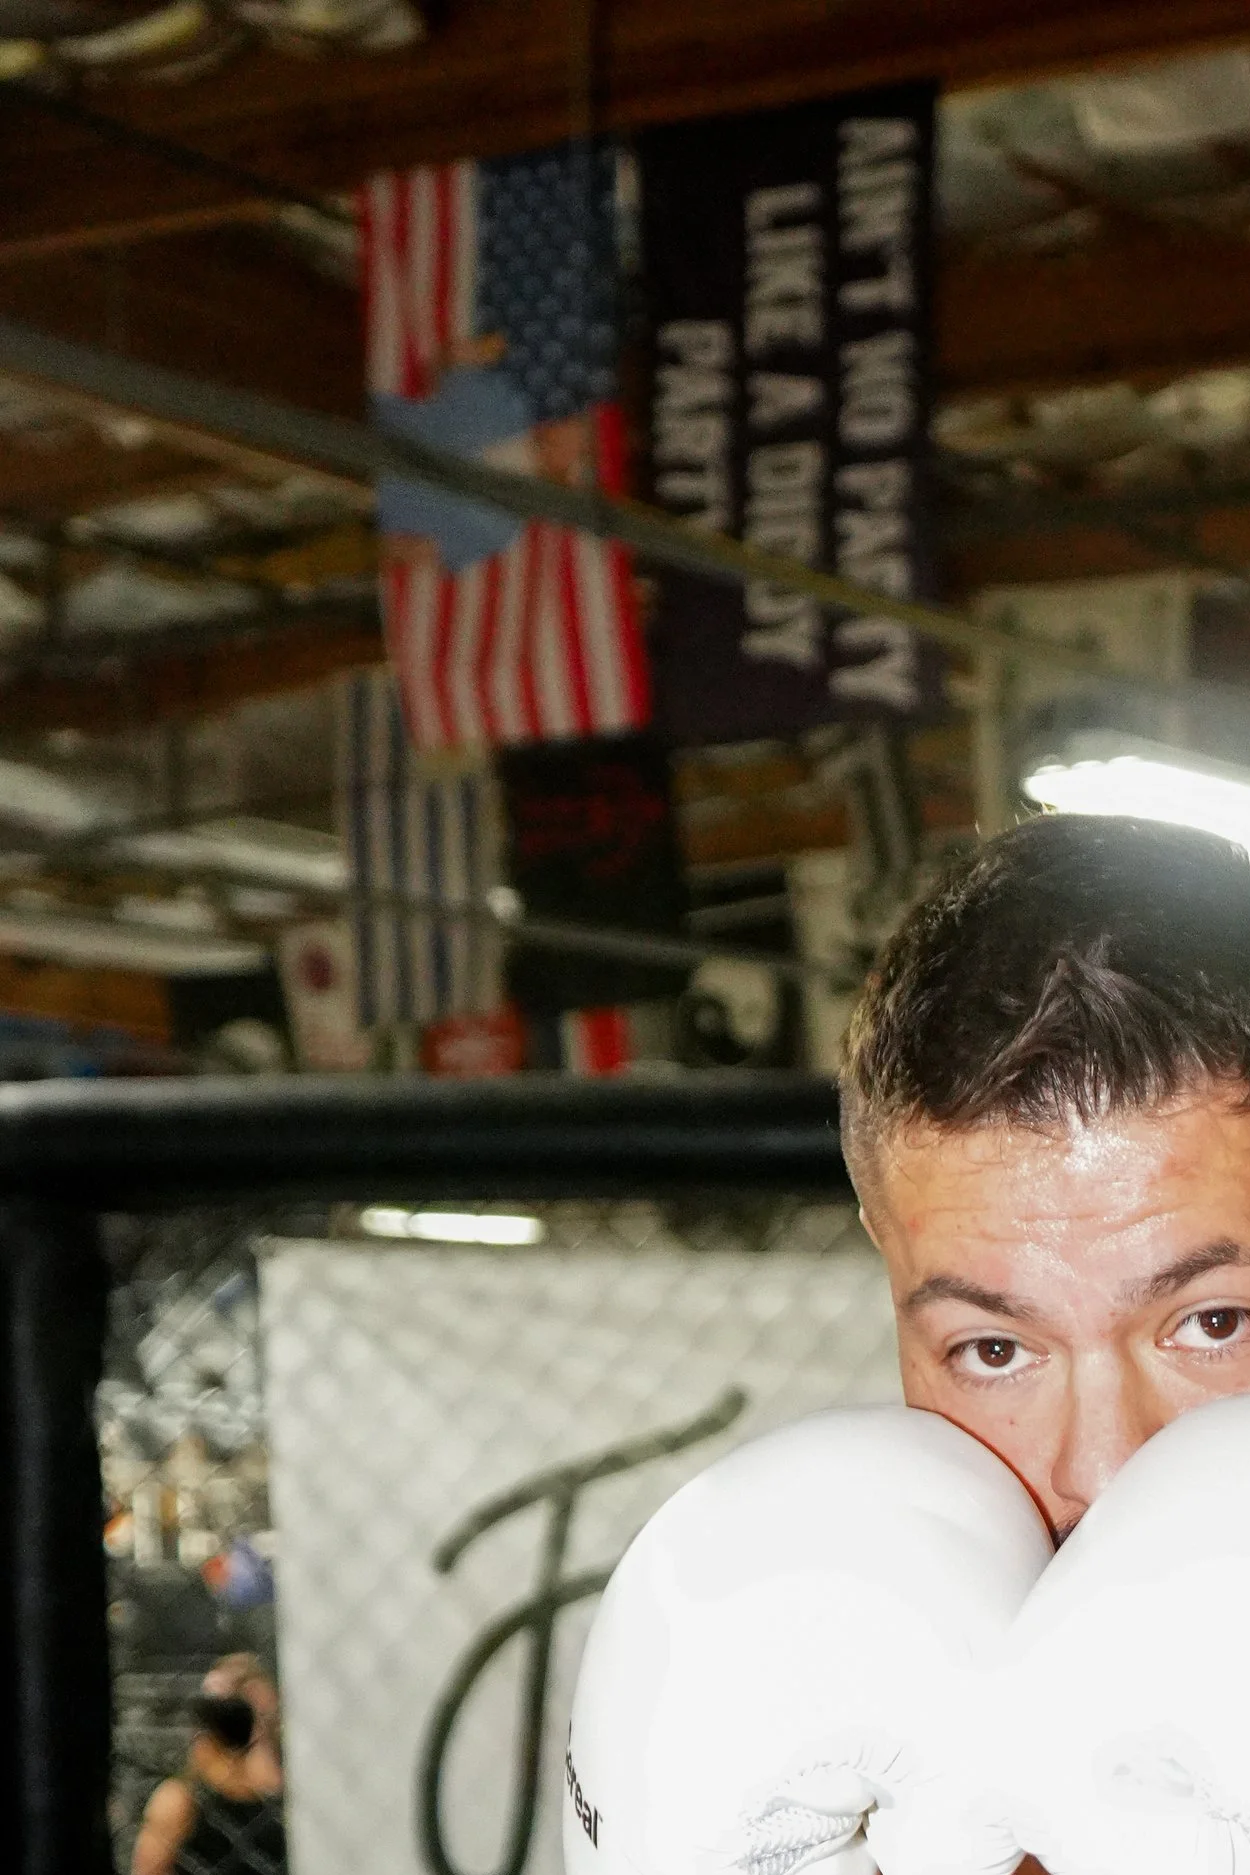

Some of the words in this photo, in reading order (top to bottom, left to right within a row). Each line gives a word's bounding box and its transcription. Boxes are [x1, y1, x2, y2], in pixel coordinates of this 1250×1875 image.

[745, 183, 823, 352] LIKE
[838, 116, 916, 312] AIN'T
[748, 370, 826, 428] A
[839, 331, 915, 446] NO
[830, 459, 918, 708] PARTY
